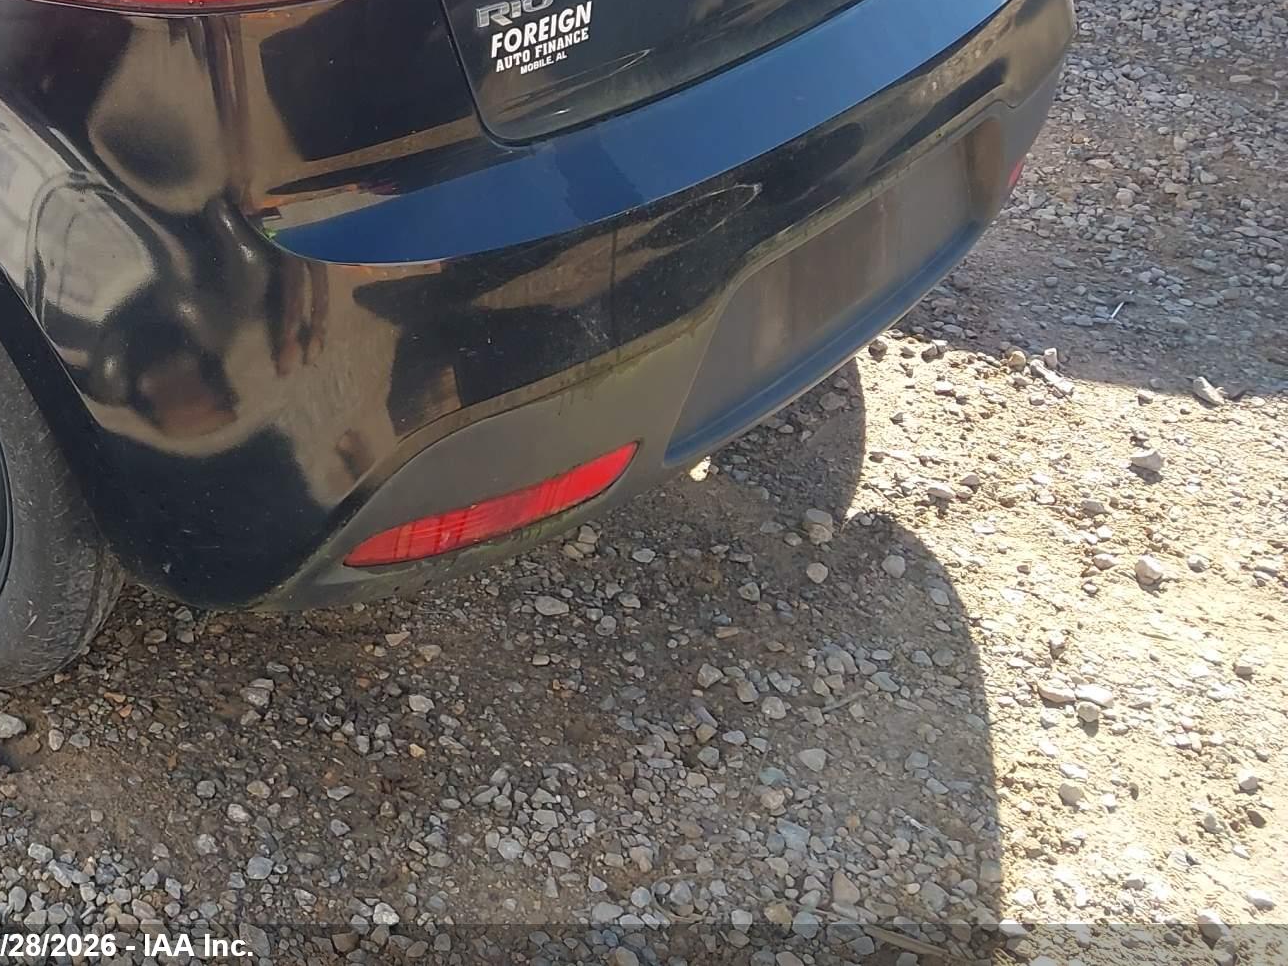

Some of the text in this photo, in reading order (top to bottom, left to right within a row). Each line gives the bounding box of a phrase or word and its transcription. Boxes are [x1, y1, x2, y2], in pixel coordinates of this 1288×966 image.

[491, 1, 593, 59] FOREIGN
[495, 26, 589, 73] AUTO FINANCE
[556, 52, 568, 62] AL
